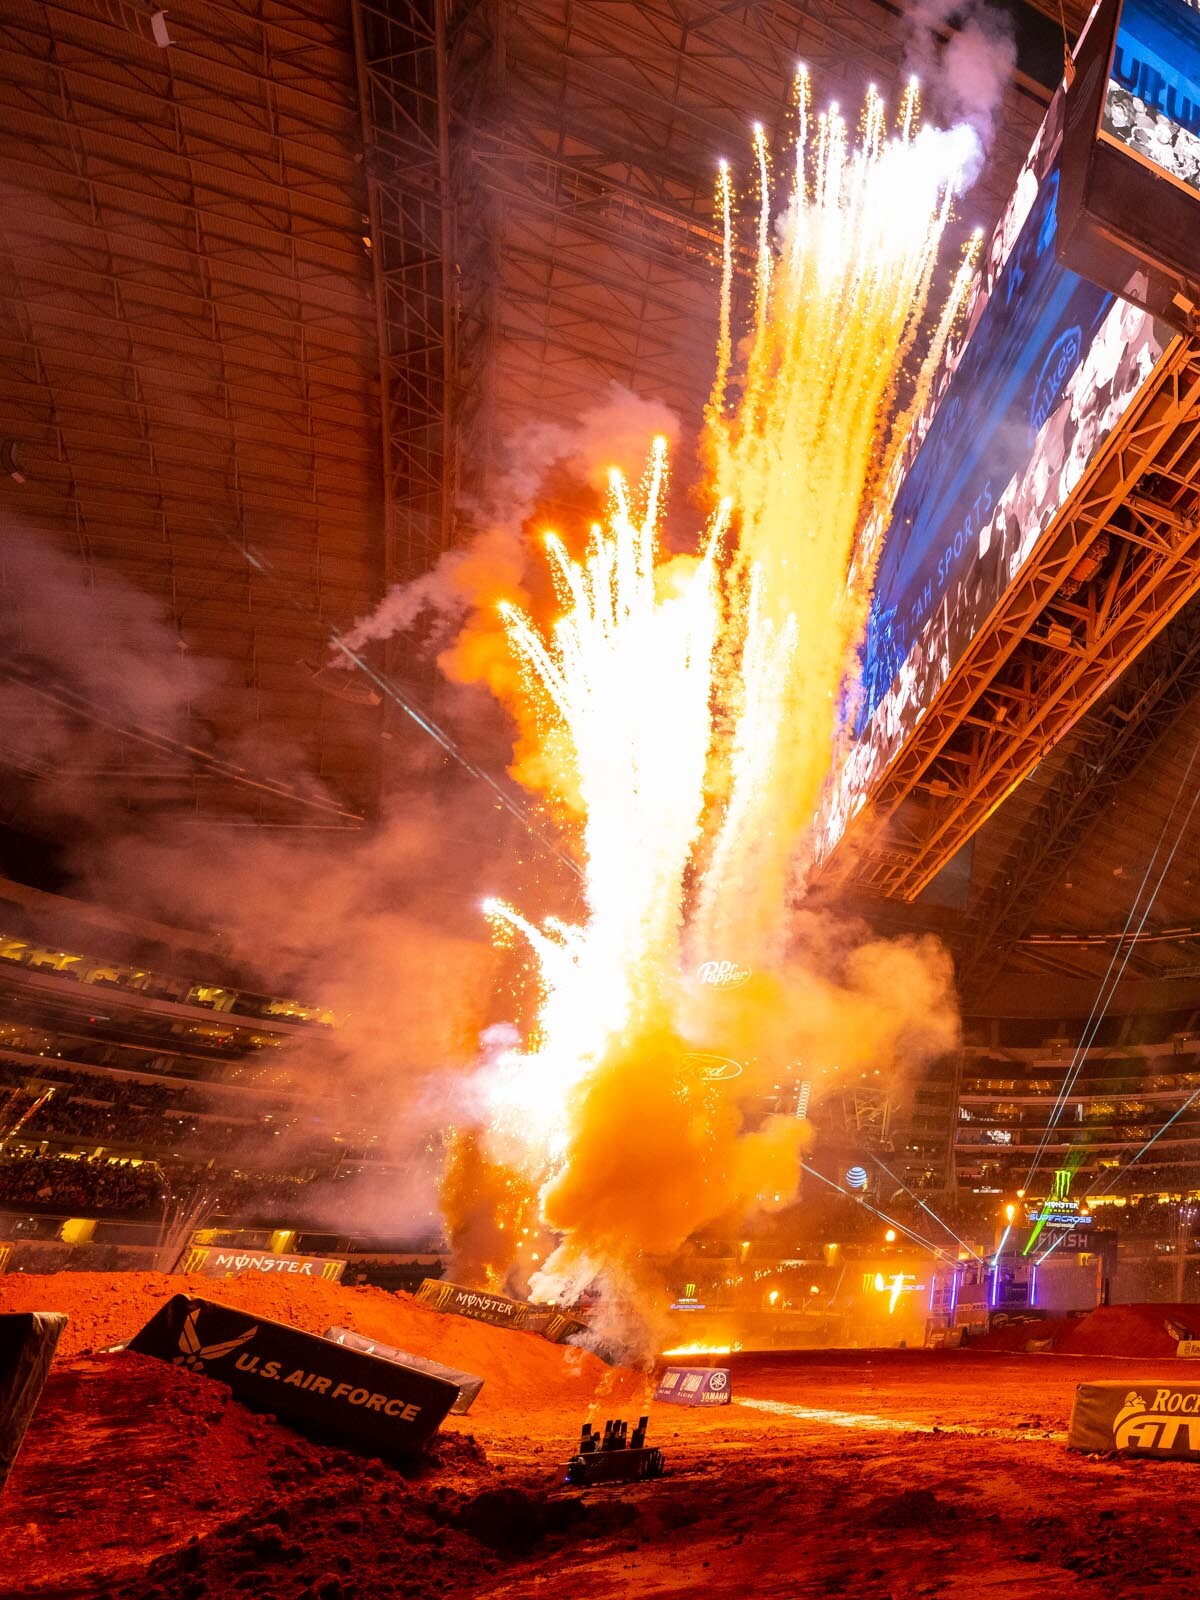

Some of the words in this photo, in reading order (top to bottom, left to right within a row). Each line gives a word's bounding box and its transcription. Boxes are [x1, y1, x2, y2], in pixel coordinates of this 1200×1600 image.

[937, 480, 992, 587] SPORTS
[701, 961, 749, 986] Pepper
[719, 960, 739, 974] Dr
[1029, 1213, 1092, 1223] SUPERCROSS
[1039, 1233, 1088, 1248] FINISH
[216, 1254, 313, 1276] MONSTER
[455, 1292, 514, 1316] MONSTER
[233, 1352, 282, 1381] U.S.
[282, 1370, 334, 1397] AIR
[330, 1383, 424, 1423] FORCE
[702, 1392, 728, 1400] YAMAHA
